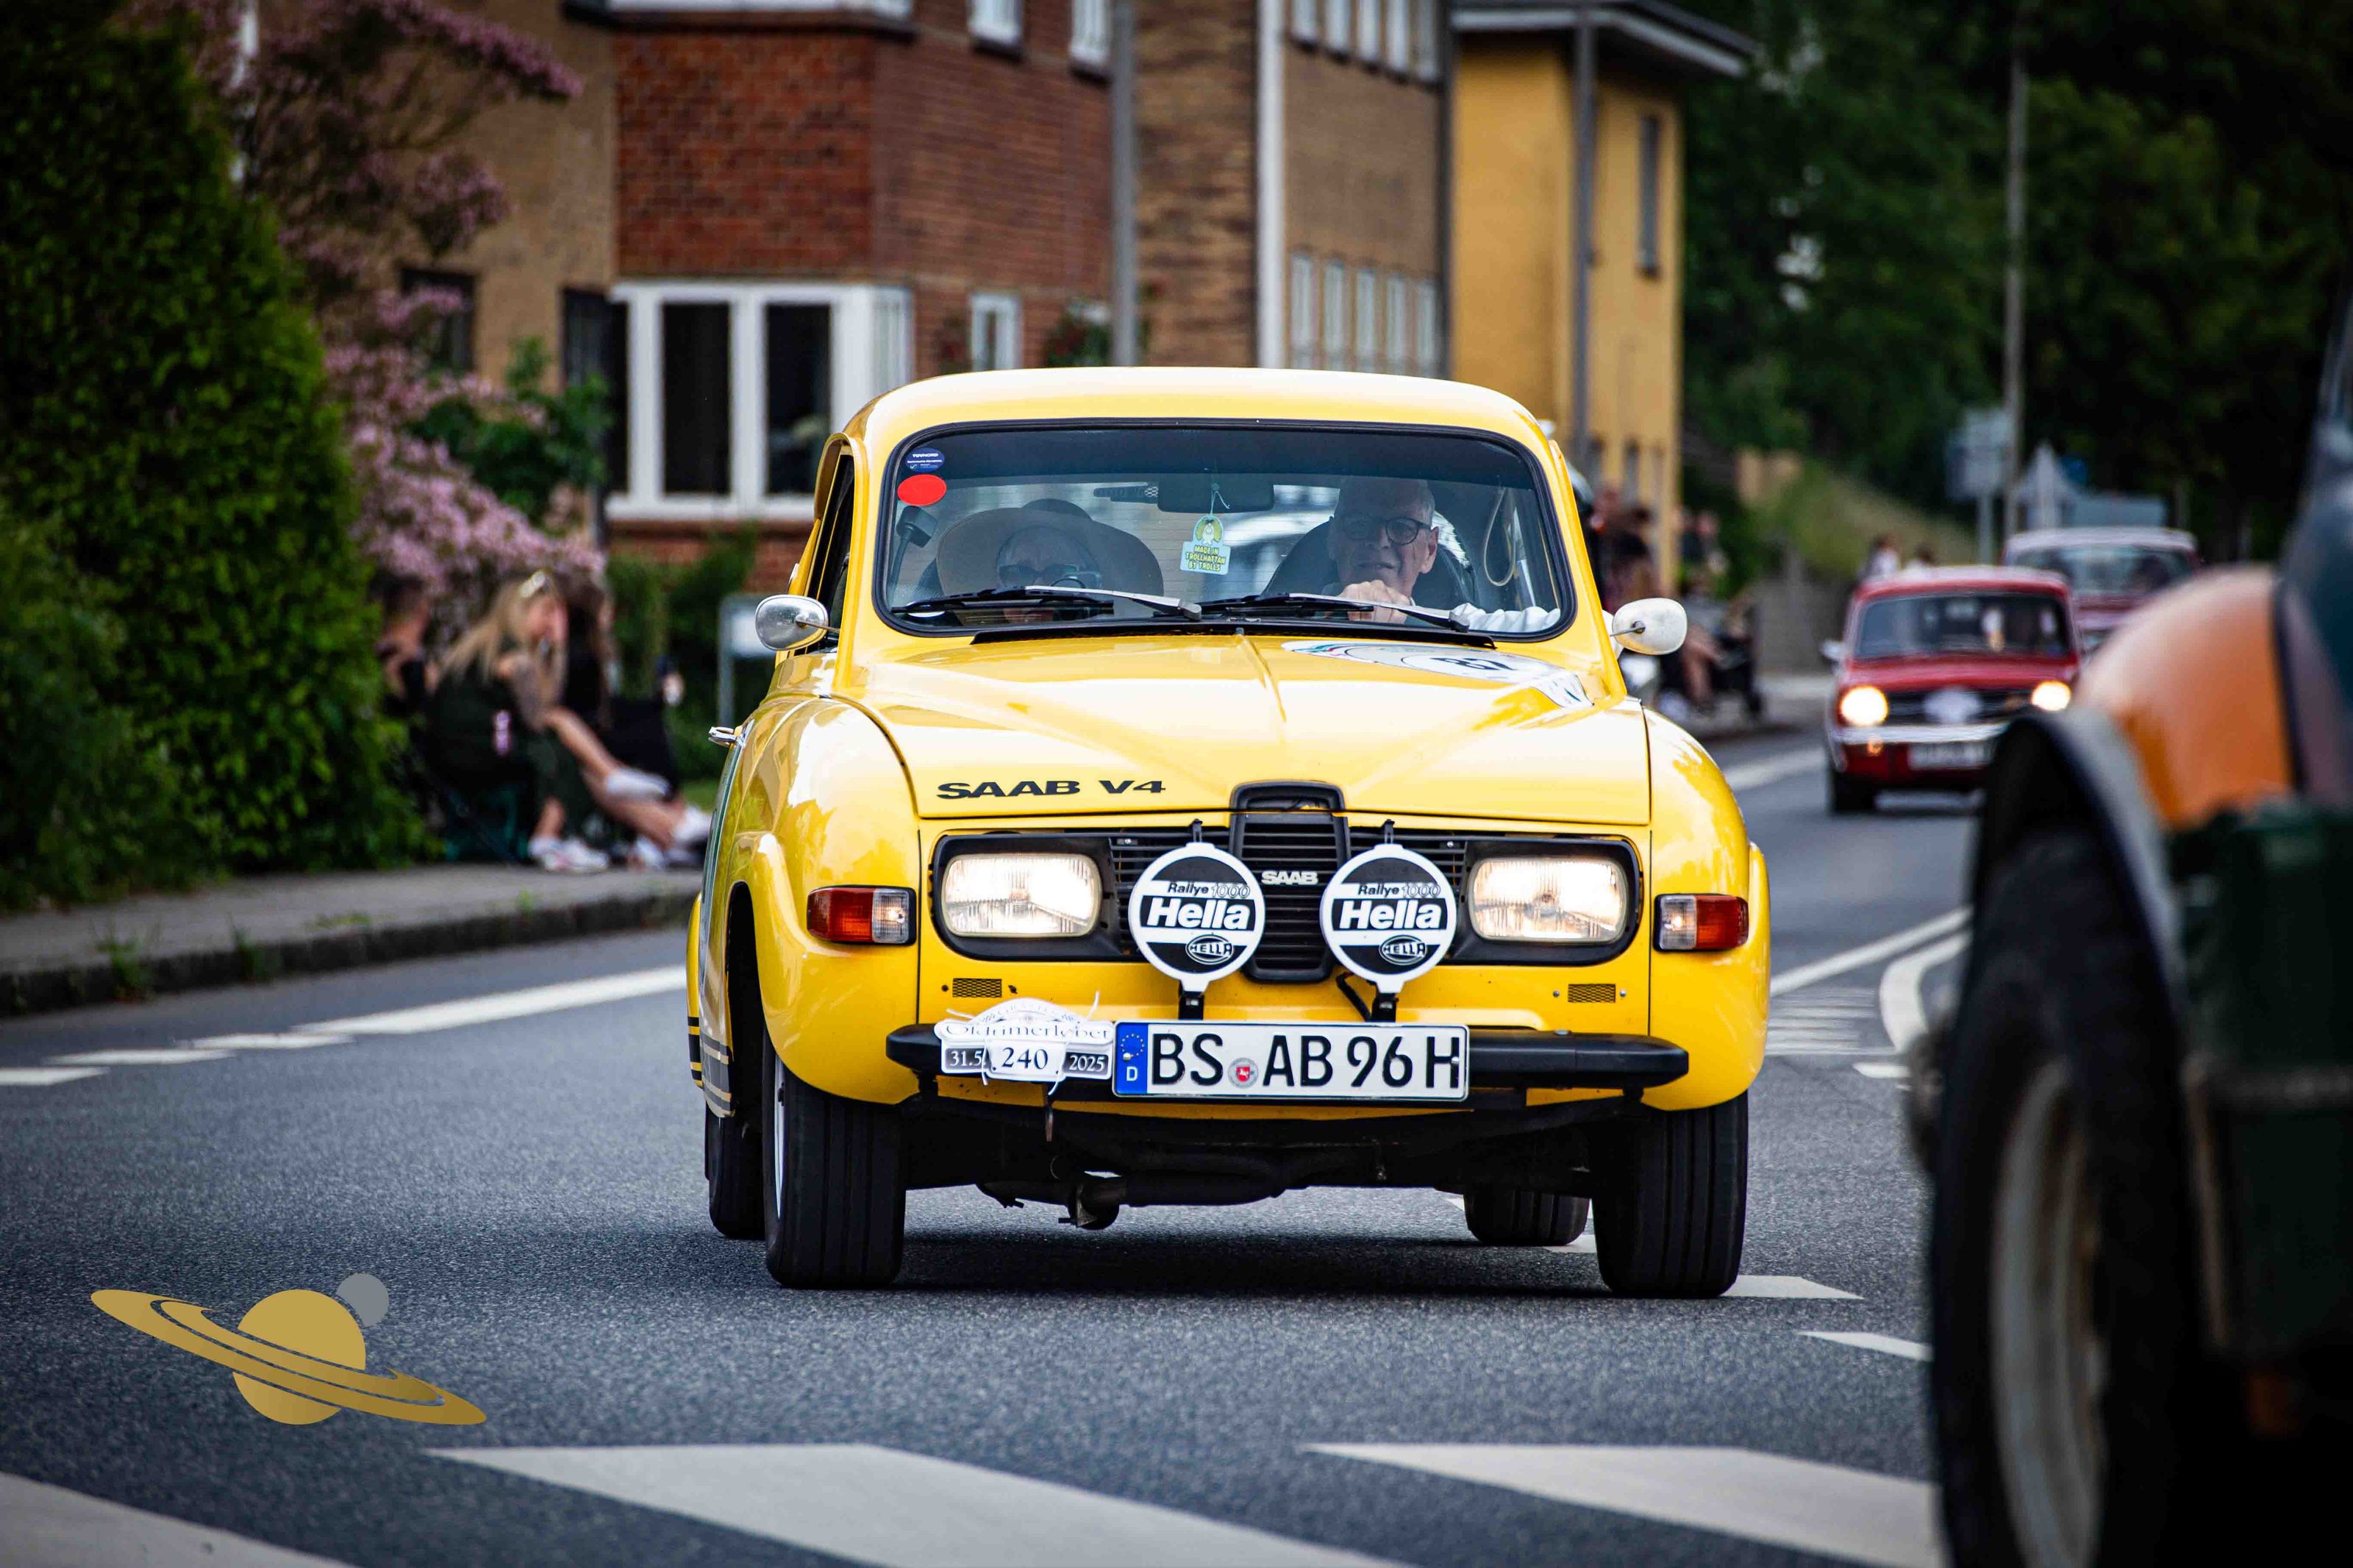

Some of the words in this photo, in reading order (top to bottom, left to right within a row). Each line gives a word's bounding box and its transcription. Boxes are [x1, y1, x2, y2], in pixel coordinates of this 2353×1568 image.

[1193, 545, 1211, 554] MADE
[1212, 548, 1219, 556] IN
[1188, 560, 1196, 569] BY
[1199, 562, 1221, 571] TROLLS
[937, 780, 1081, 799] SAAB
[1099, 780, 1166, 794] V4
[1261, 870, 1318, 885] SAAB
[1168, 882, 1209, 896] Rallye
[1211, 883, 1251, 898] 1000
[1358, 883, 1400, 898] Rallye
[1402, 883, 1441, 898] 1000
[1146, 897, 1251, 930] Hella
[1339, 899, 1442, 930] Hella
[1189, 942, 1232, 956] HELLA
[1383, 942, 1426, 956] HELLA
[1001, 1047, 1049, 1070] 240
[1069, 1055, 1105, 1072] 2025
[1151, 1033, 1224, 1086] BS
[1126, 1066, 1138, 1082] D
